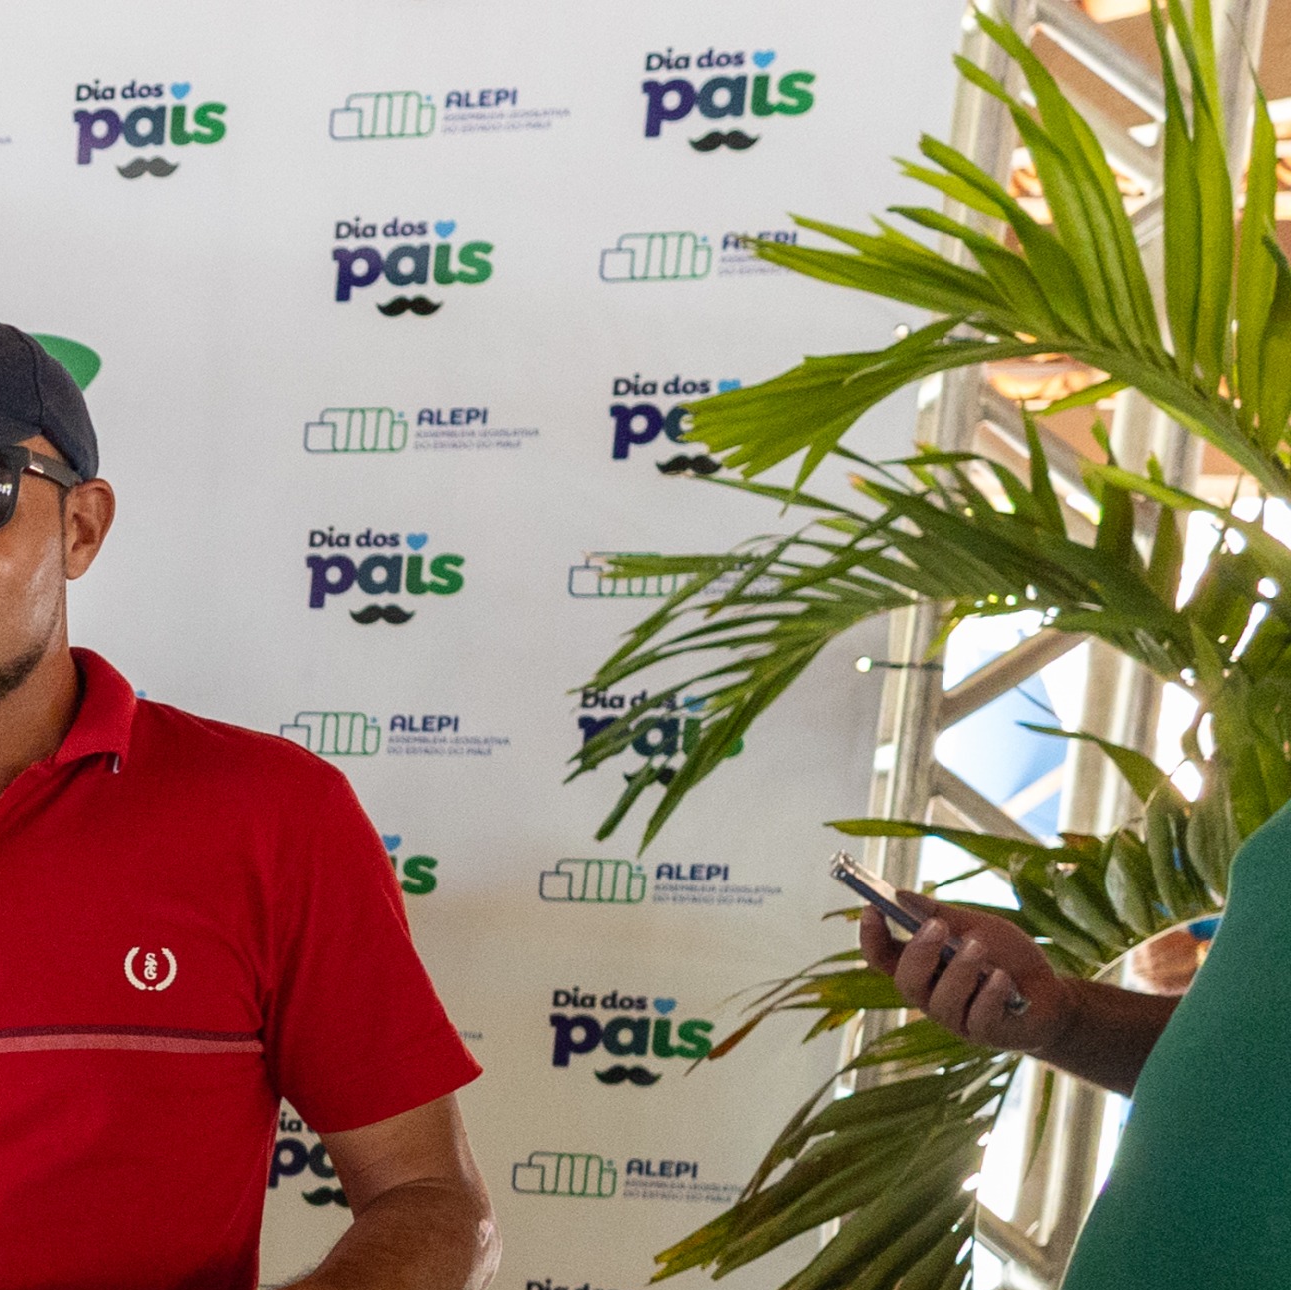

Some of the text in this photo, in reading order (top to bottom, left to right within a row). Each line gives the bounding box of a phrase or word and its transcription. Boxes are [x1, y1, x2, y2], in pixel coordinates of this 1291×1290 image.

[645, 46, 745, 72] Dia dos
[75, 77, 164, 101] Dia dos
[445, 88, 518, 108] ALEPI
[642, 70, 816, 137] pais
[73, 100, 227, 165] pais
[334, 217, 427, 240] Dia dos
[332, 240, 493, 301] pais
[613, 373, 710, 397] Dia dos
[417, 408, 488, 425] ALEPI
[309, 525, 400, 549] Dia dos
[306, 554, 465, 608] pais
[389, 714, 459, 732] ALEPI
[656, 863, 729, 881] ALEPI
[552, 986, 648, 1011] Dia dos
[550, 1013, 715, 1067] pais
[626, 1158, 699, 1179] ALEPI
